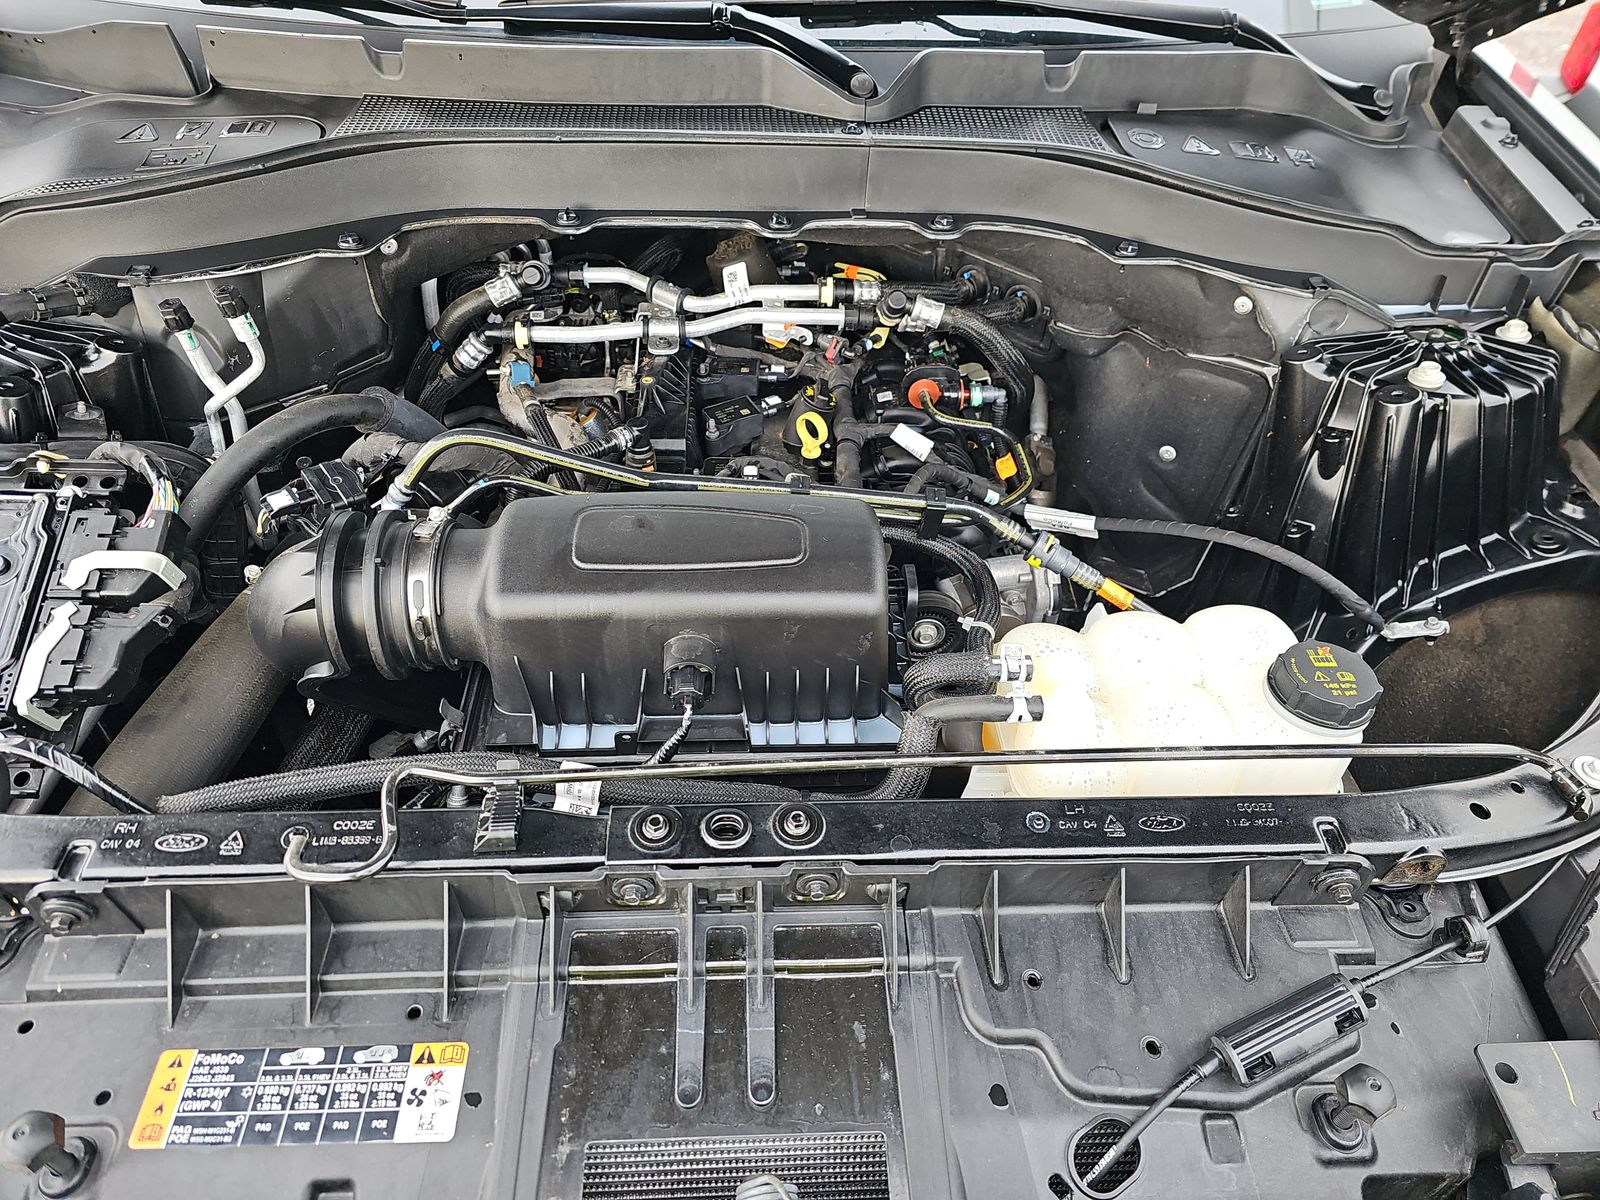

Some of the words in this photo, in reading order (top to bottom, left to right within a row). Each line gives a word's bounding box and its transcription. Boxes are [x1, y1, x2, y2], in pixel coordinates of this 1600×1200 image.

[1064, 804, 1085, 815] LH
[113, 822, 138, 834] RH
[1058, 820, 1078, 829] CAV
[1083, 820, 1097, 829] 04
[100, 839, 123, 850] CAV
[125, 838, 141, 849] 04
[195, 1052, 245, 1066] FoMoCo
[191, 1066, 210, 1074] SAE
[184, 1086, 231, 1099] R-1234yf
[280, 1085, 290, 1097] kg
[316, 1084, 327, 1096] kg
[357, 1082, 368, 1094] kg
[394, 1081, 404, 1094] kg
[179, 1100, 210, 1112] (GWP
[211, 1099, 223, 1112] 4)
[171, 1125, 192, 1135] PAG
[255, 1122, 272, 1132] PAG
[294, 1121, 311, 1132] POE
[332, 1120, 350, 1131] PAG
[168, 1134, 189, 1144] POE
